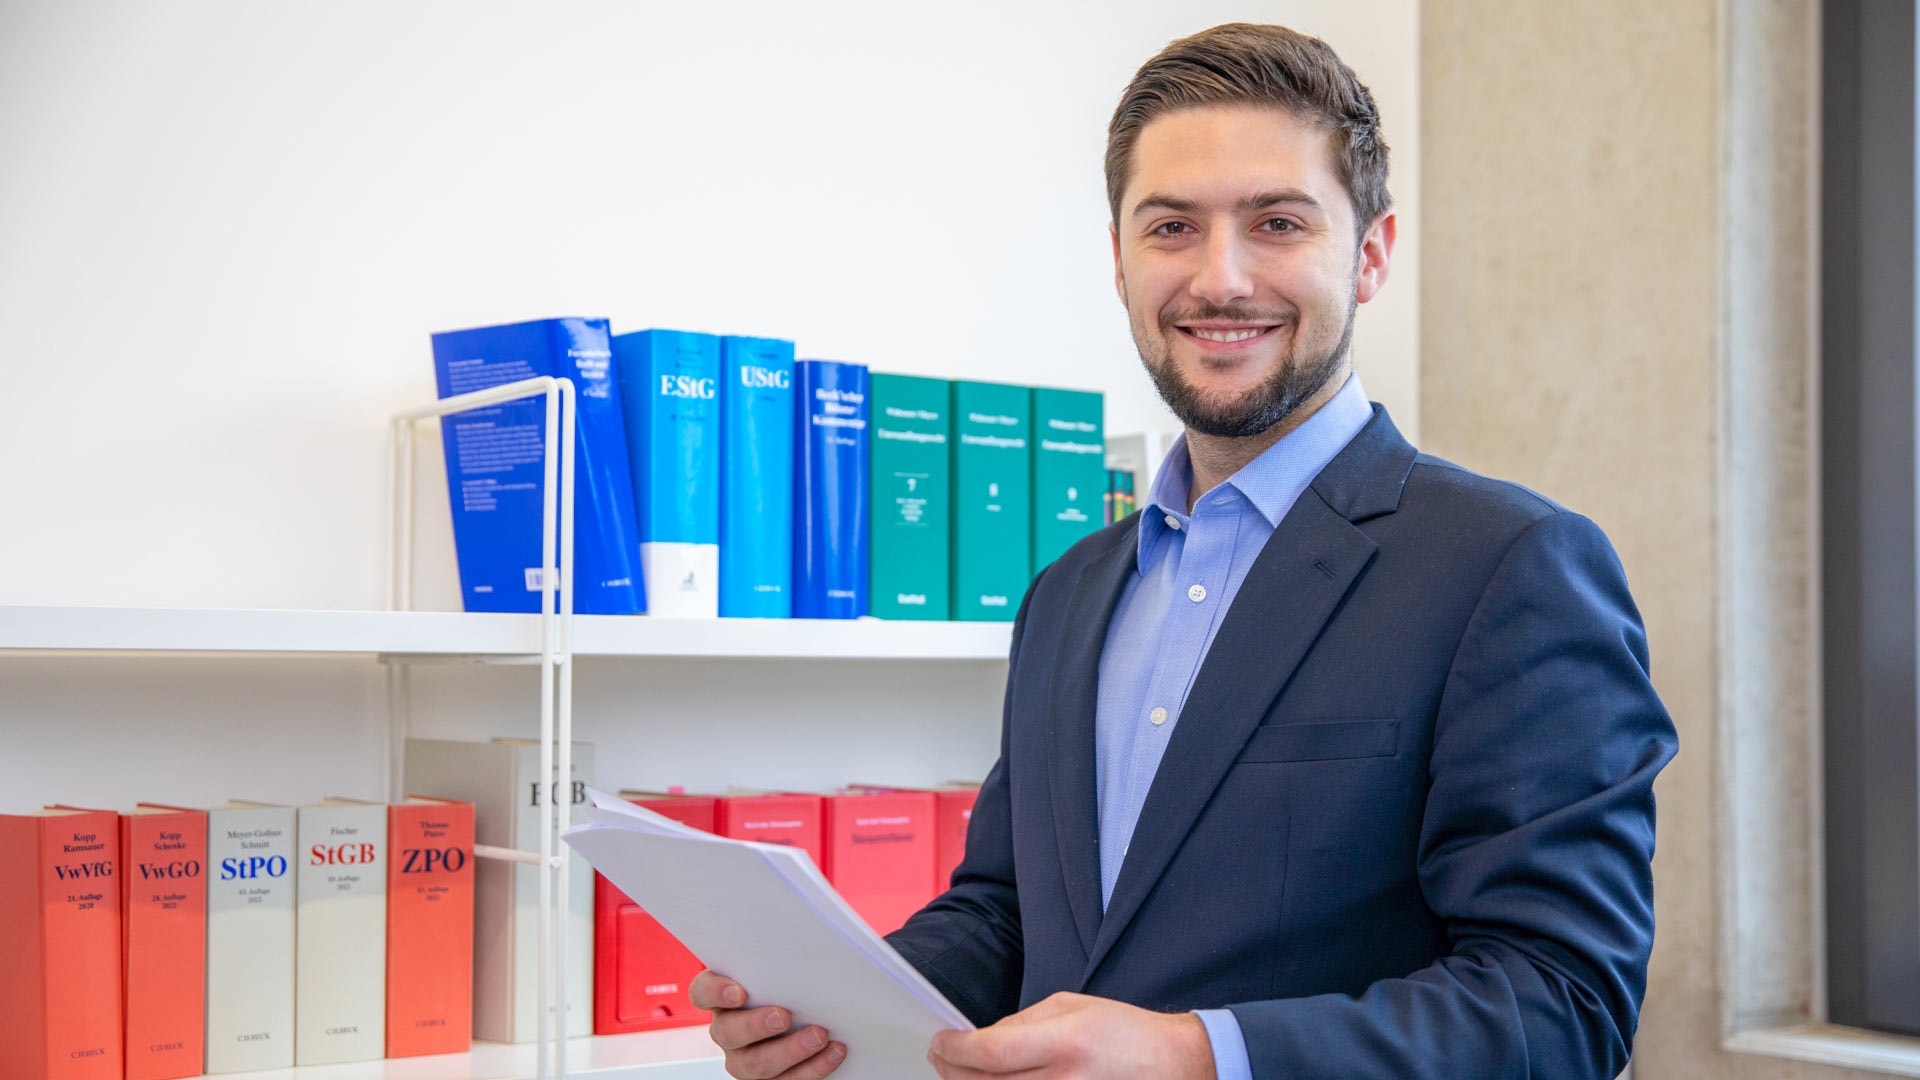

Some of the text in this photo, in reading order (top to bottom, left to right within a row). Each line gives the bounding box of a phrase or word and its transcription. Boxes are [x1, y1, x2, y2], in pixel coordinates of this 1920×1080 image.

[661, 374, 715, 399] EStG
[741, 365, 790, 389] UStG
[73, 833, 96, 843] Kopp
[159, 832, 182, 841] Kopp
[330, 827, 358, 836] Fischer
[63, 843, 105, 853] Ramsauer
[153, 842, 186, 851] Schenke
[309, 842, 376, 867] StGB
[138, 859, 200, 881] VwGO
[220, 854, 288, 881] StPO
[401, 846, 465, 874] ZPO
[54, 861, 113, 881] VwVfG
[79, 893, 103, 902] Auflage
